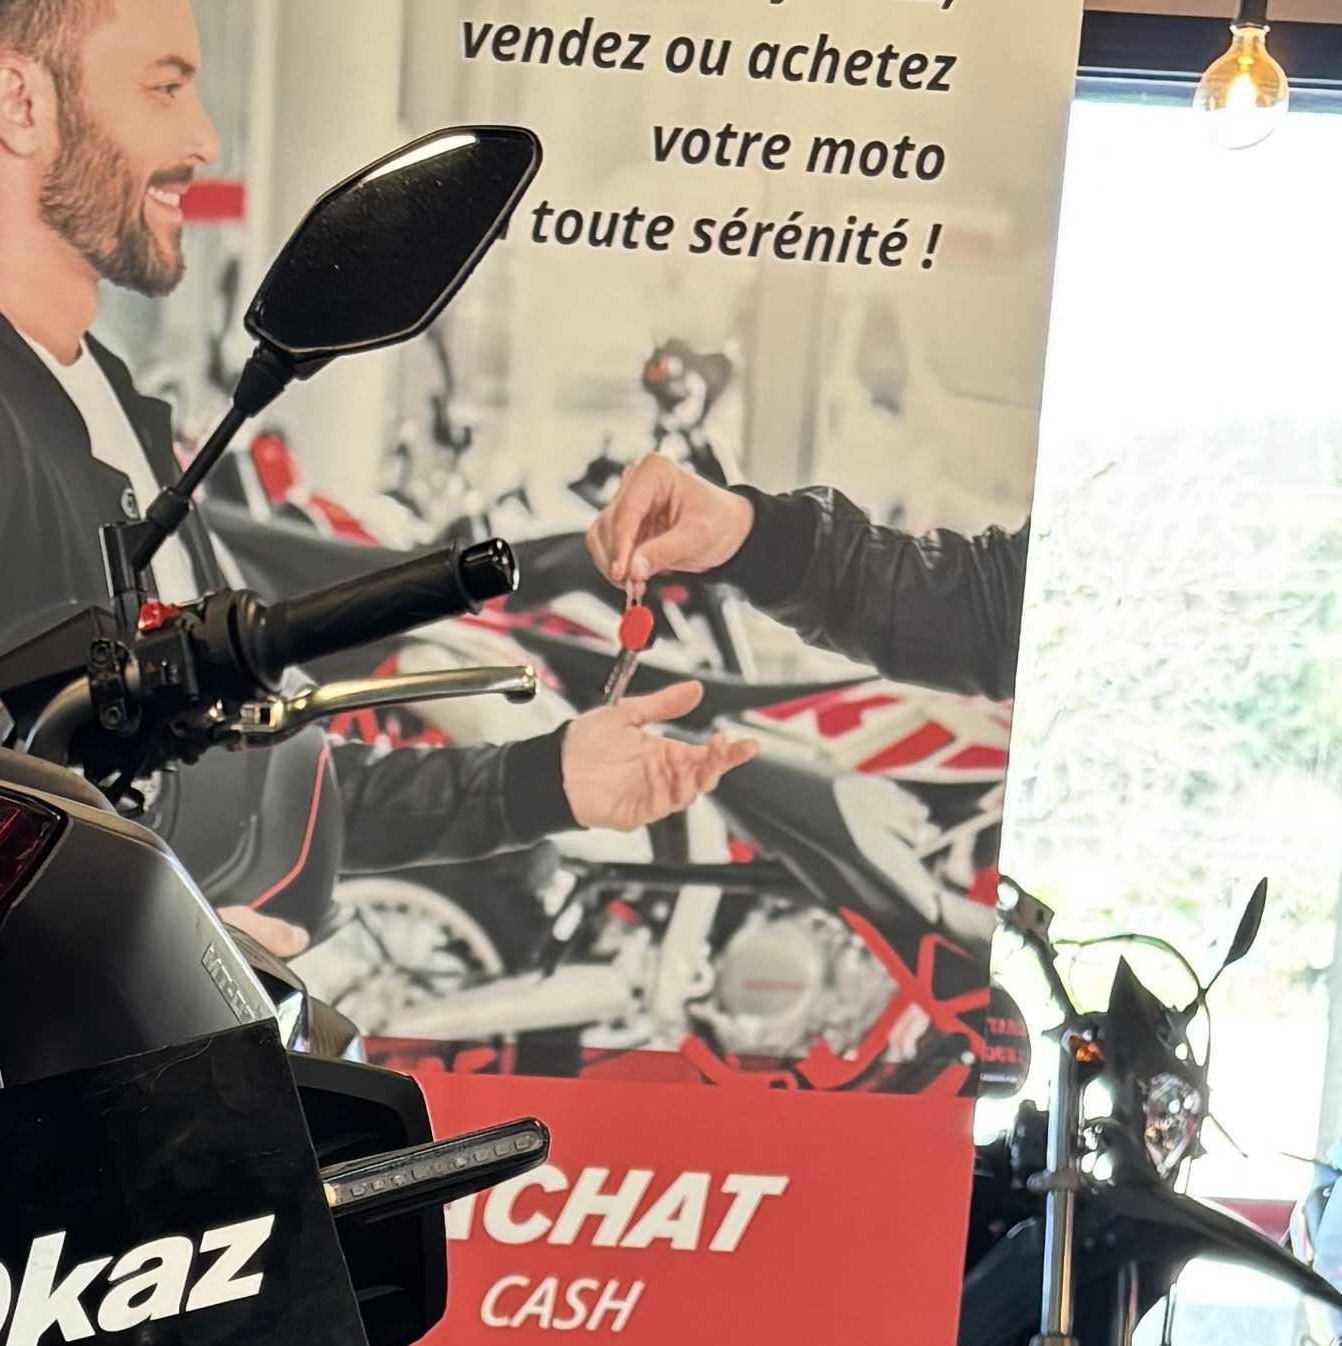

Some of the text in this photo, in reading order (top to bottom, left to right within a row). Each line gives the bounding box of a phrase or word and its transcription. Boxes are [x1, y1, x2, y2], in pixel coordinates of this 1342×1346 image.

[462, 17, 958, 93] vendez ou achetez
[652, 122, 947, 182] votre moto
[530, 198, 675, 252] toute
[688, 206, 909, 268] sérénité
[444, 1164, 790, 1253] CHAT
[480, 1275, 646, 1333] CASH
